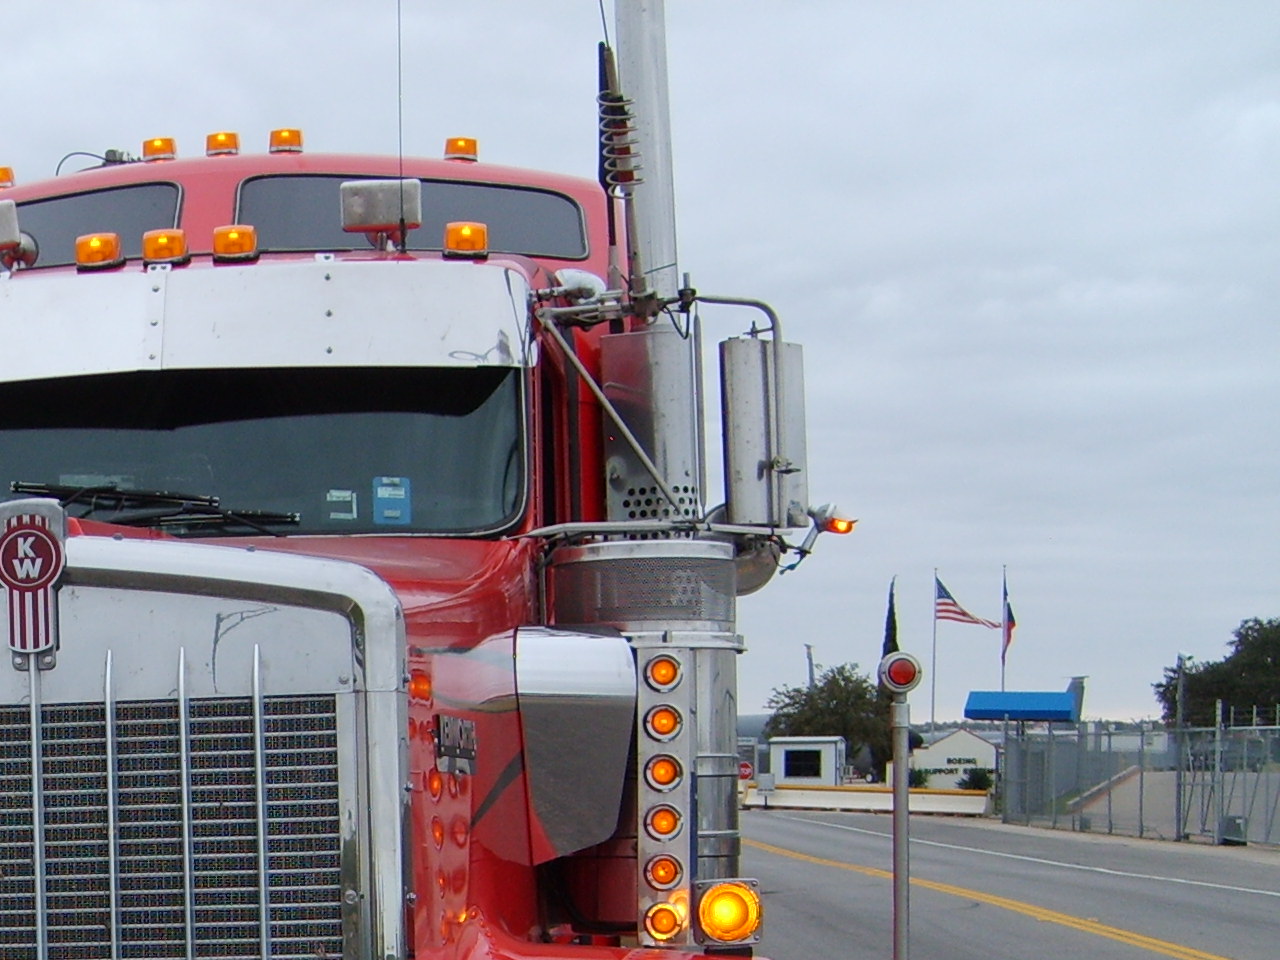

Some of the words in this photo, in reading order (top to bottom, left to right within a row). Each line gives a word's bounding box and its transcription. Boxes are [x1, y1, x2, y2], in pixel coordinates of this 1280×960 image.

[17, 536, 36, 559] K
[12, 558, 42, 580] W
[946, 757, 977, 765] BOEING
